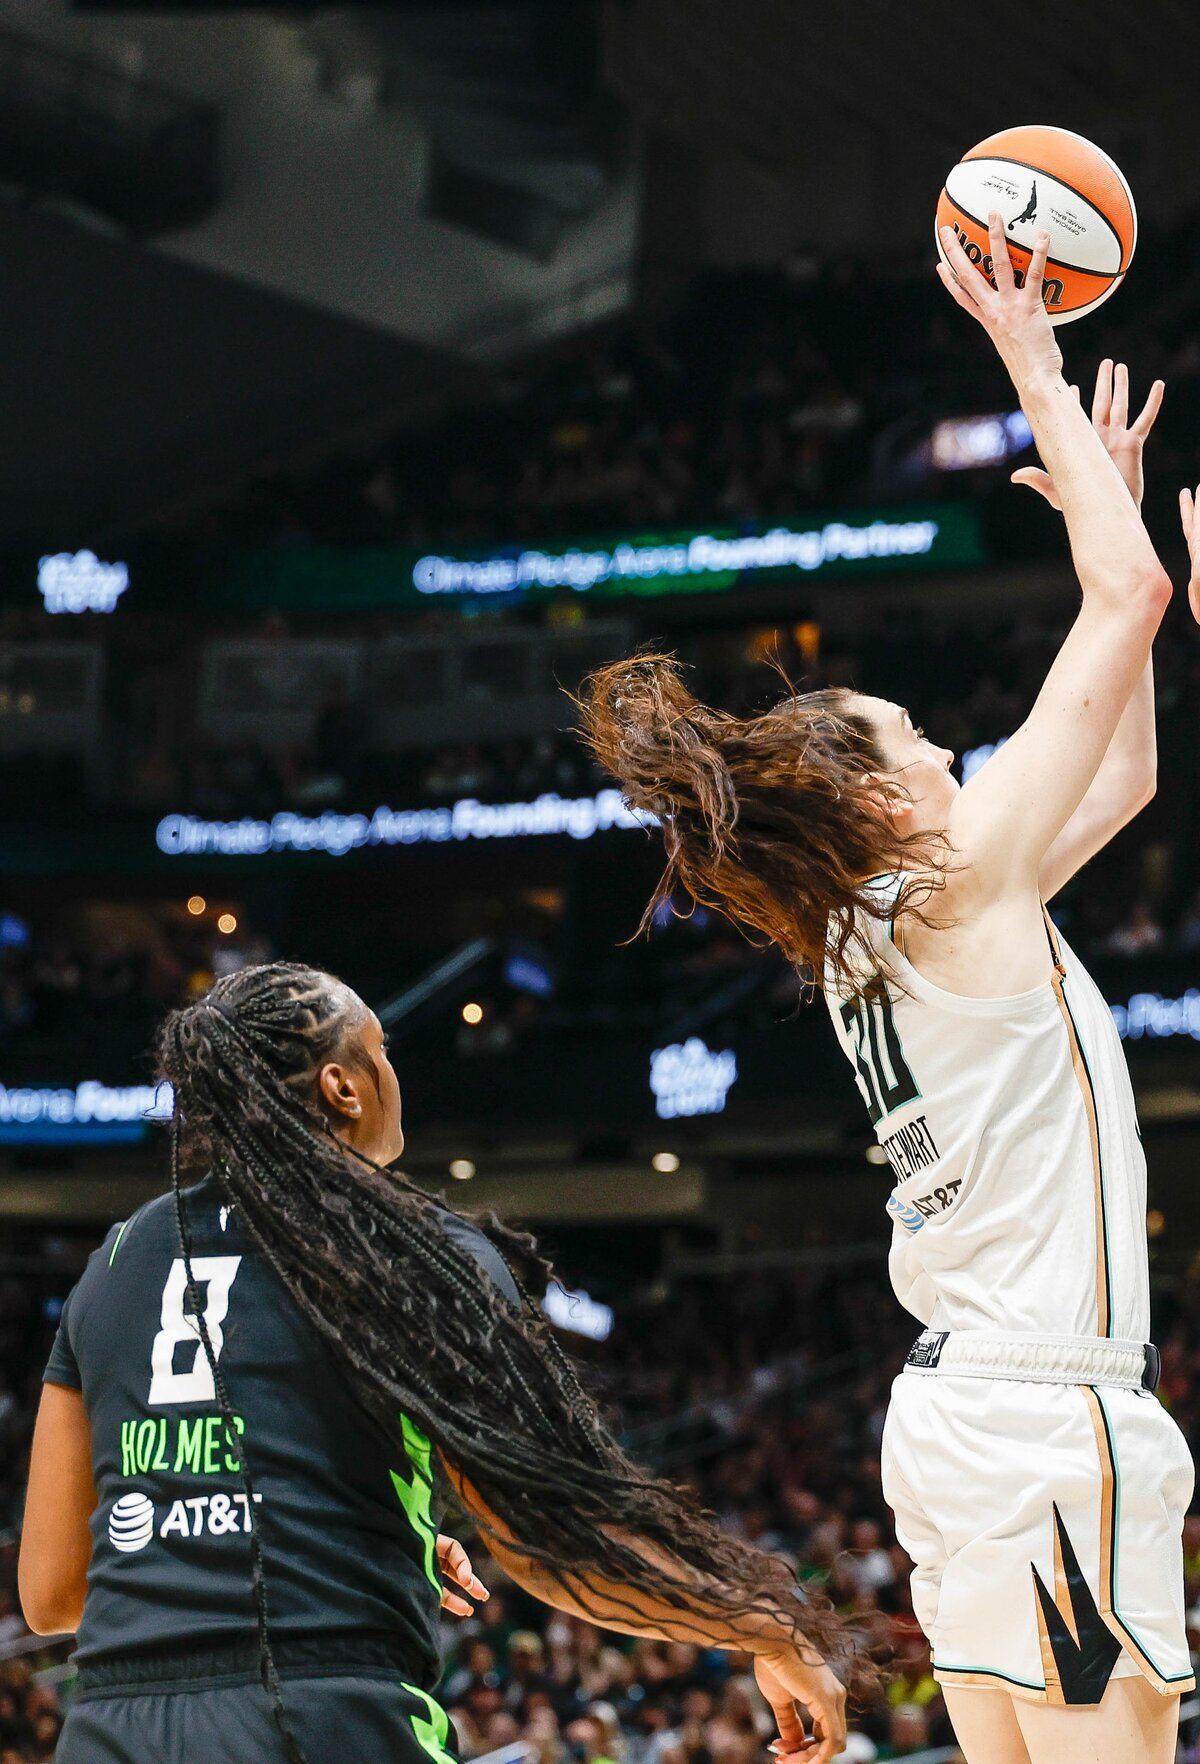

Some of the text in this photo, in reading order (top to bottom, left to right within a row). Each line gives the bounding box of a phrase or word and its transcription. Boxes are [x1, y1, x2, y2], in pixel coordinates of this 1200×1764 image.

[1049, 208, 1068, 221] BALL
[1051, 215, 1080, 236] OFFICIAL
[1067, 219, 1087, 233] GAME
[912, 1178, 962, 1219] AT&T
[148, 1256, 242, 1405] 8
[120, 1416, 245, 1477] HOLMES
[160, 1493, 262, 1539] AT&T
